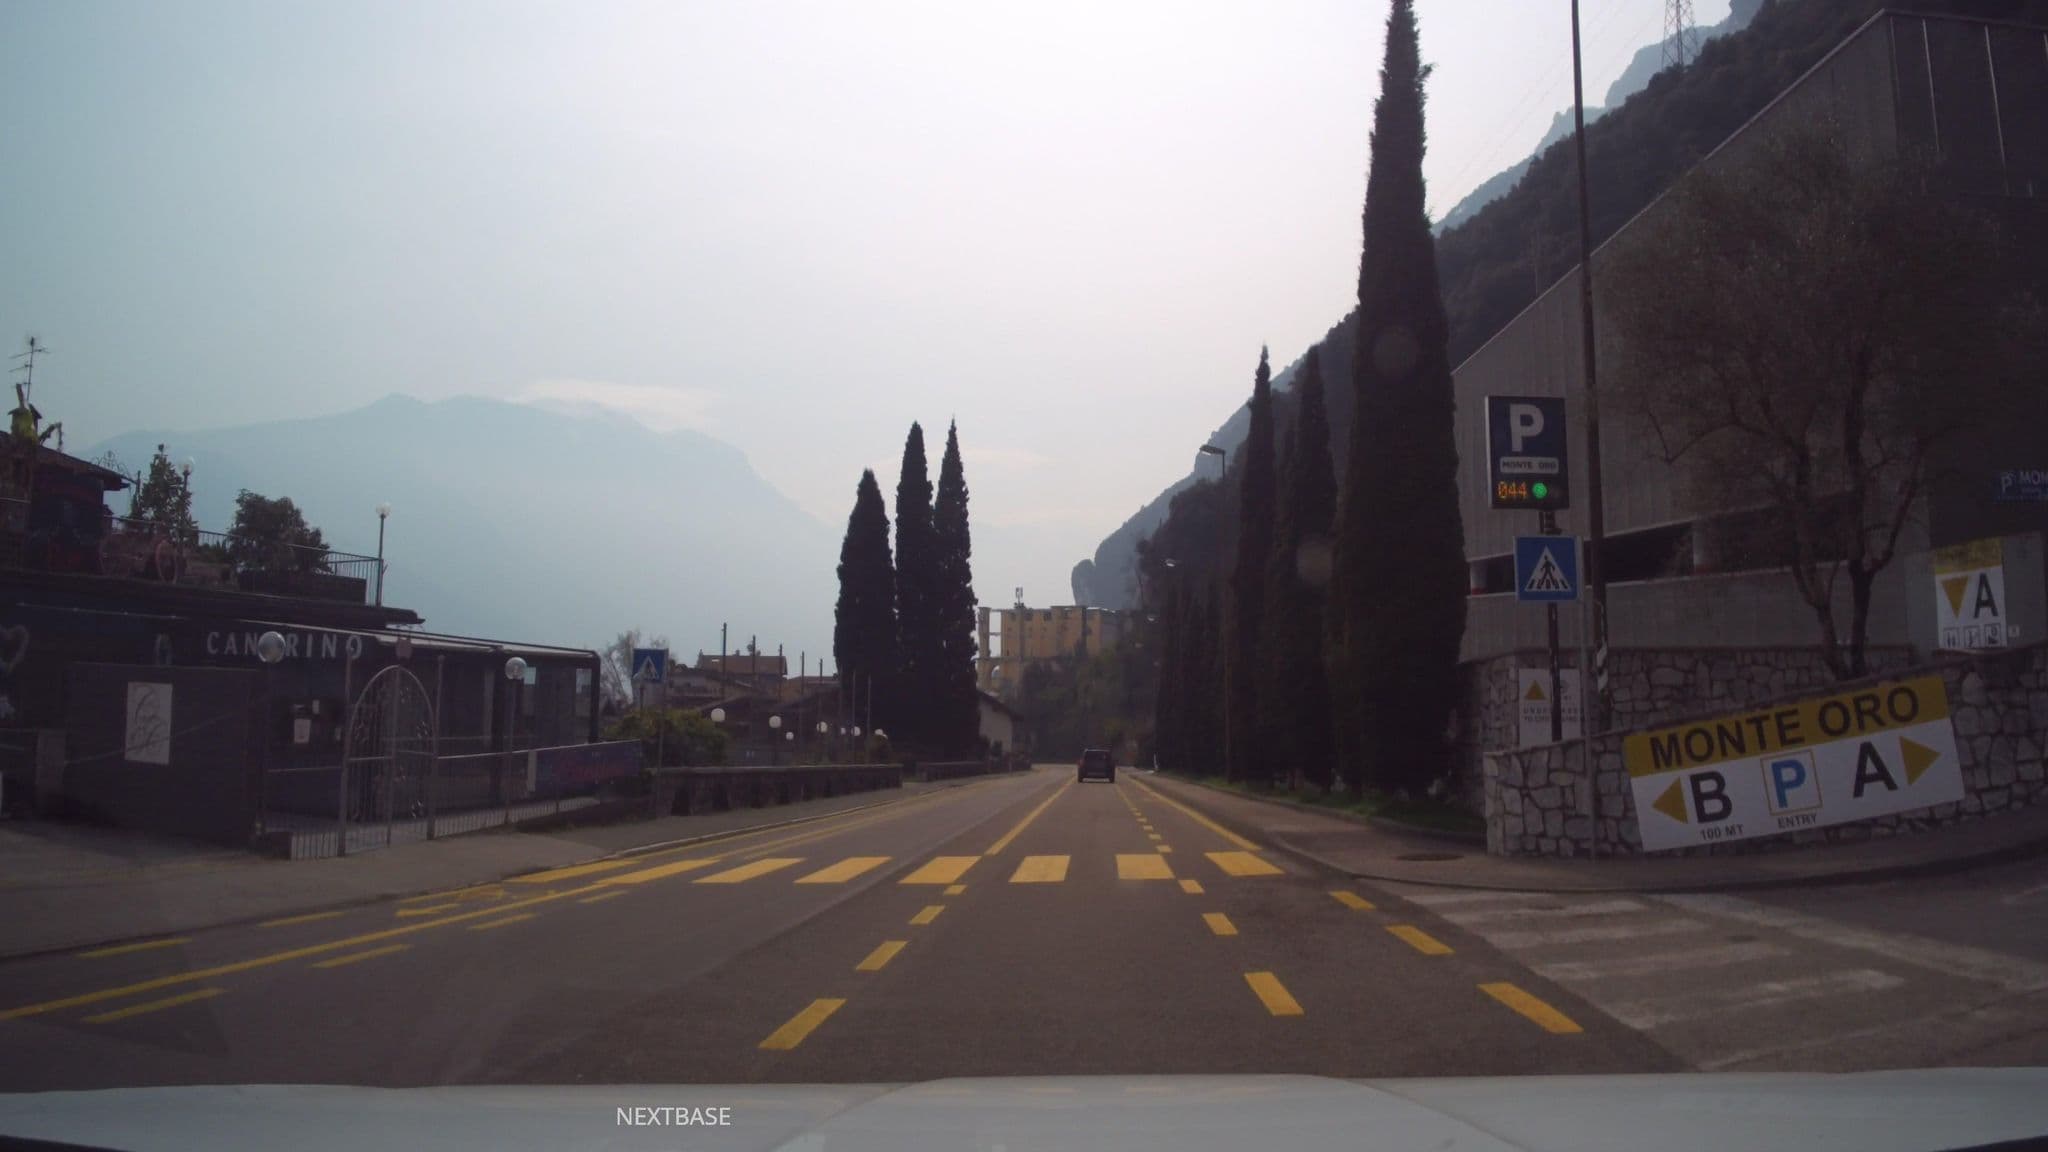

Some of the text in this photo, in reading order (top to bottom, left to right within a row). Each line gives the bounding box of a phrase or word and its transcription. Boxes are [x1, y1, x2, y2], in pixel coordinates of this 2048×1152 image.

[1509, 403, 1544, 452] P
[1502, 460, 1557, 470] MONTE ORO
[1497, 480, 1528, 500] 044
[1973, 573, 1999, 619] A
[206, 631, 363, 660] CANRINO
[1649, 685, 1920, 769] MONTE ORO
[1689, 741, 1898, 824] B P A
[1700, 823, 1744, 841] 100 MT
[1777, 813, 1818, 829] ENTRY
